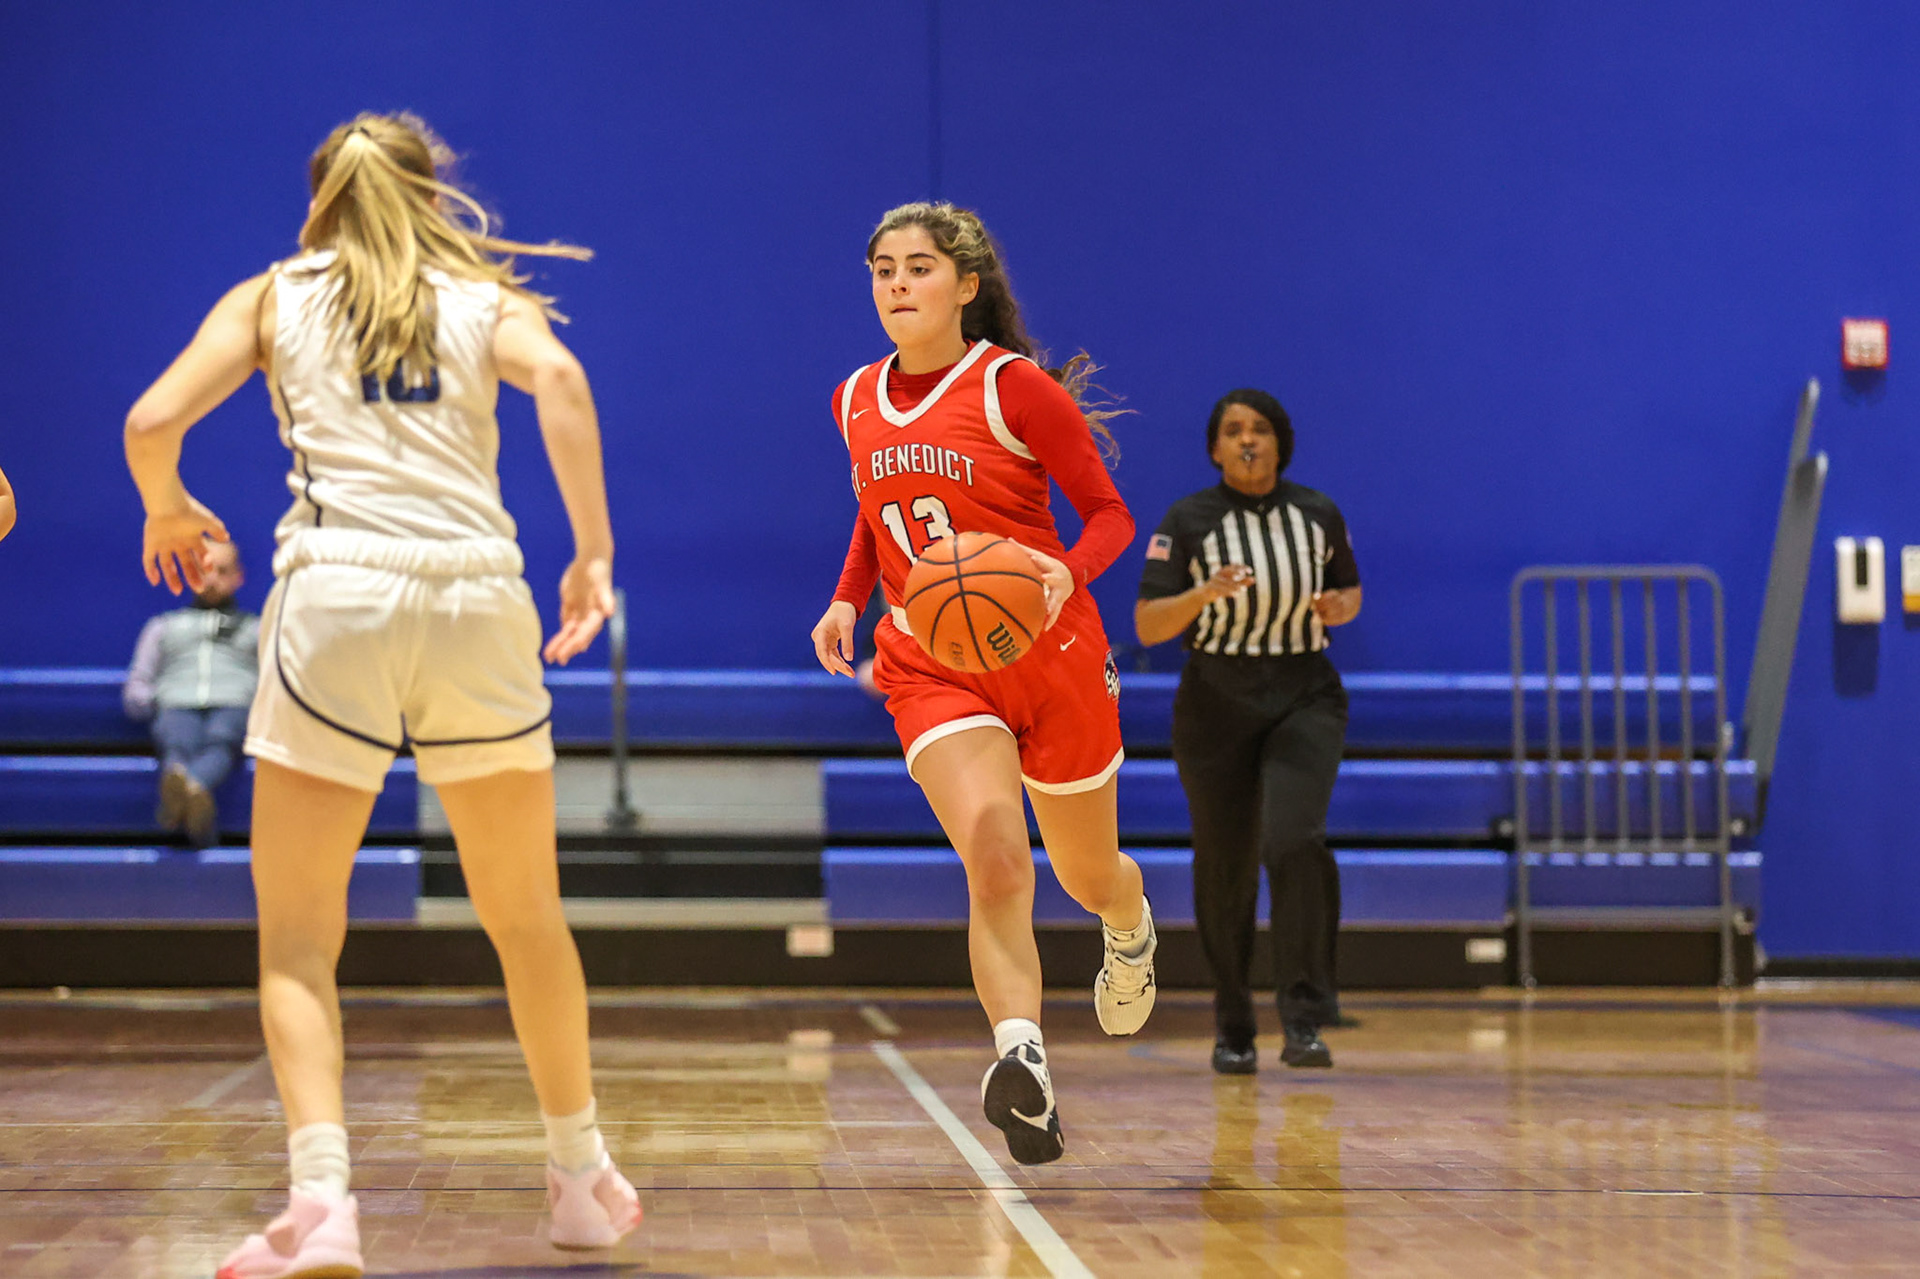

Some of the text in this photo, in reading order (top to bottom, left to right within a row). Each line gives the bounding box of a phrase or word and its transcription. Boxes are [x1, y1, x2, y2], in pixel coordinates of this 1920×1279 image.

[851, 443, 975, 502] T. BENEDICT
[880, 494, 958, 567] 13
[986, 621, 1021, 667] Wil
